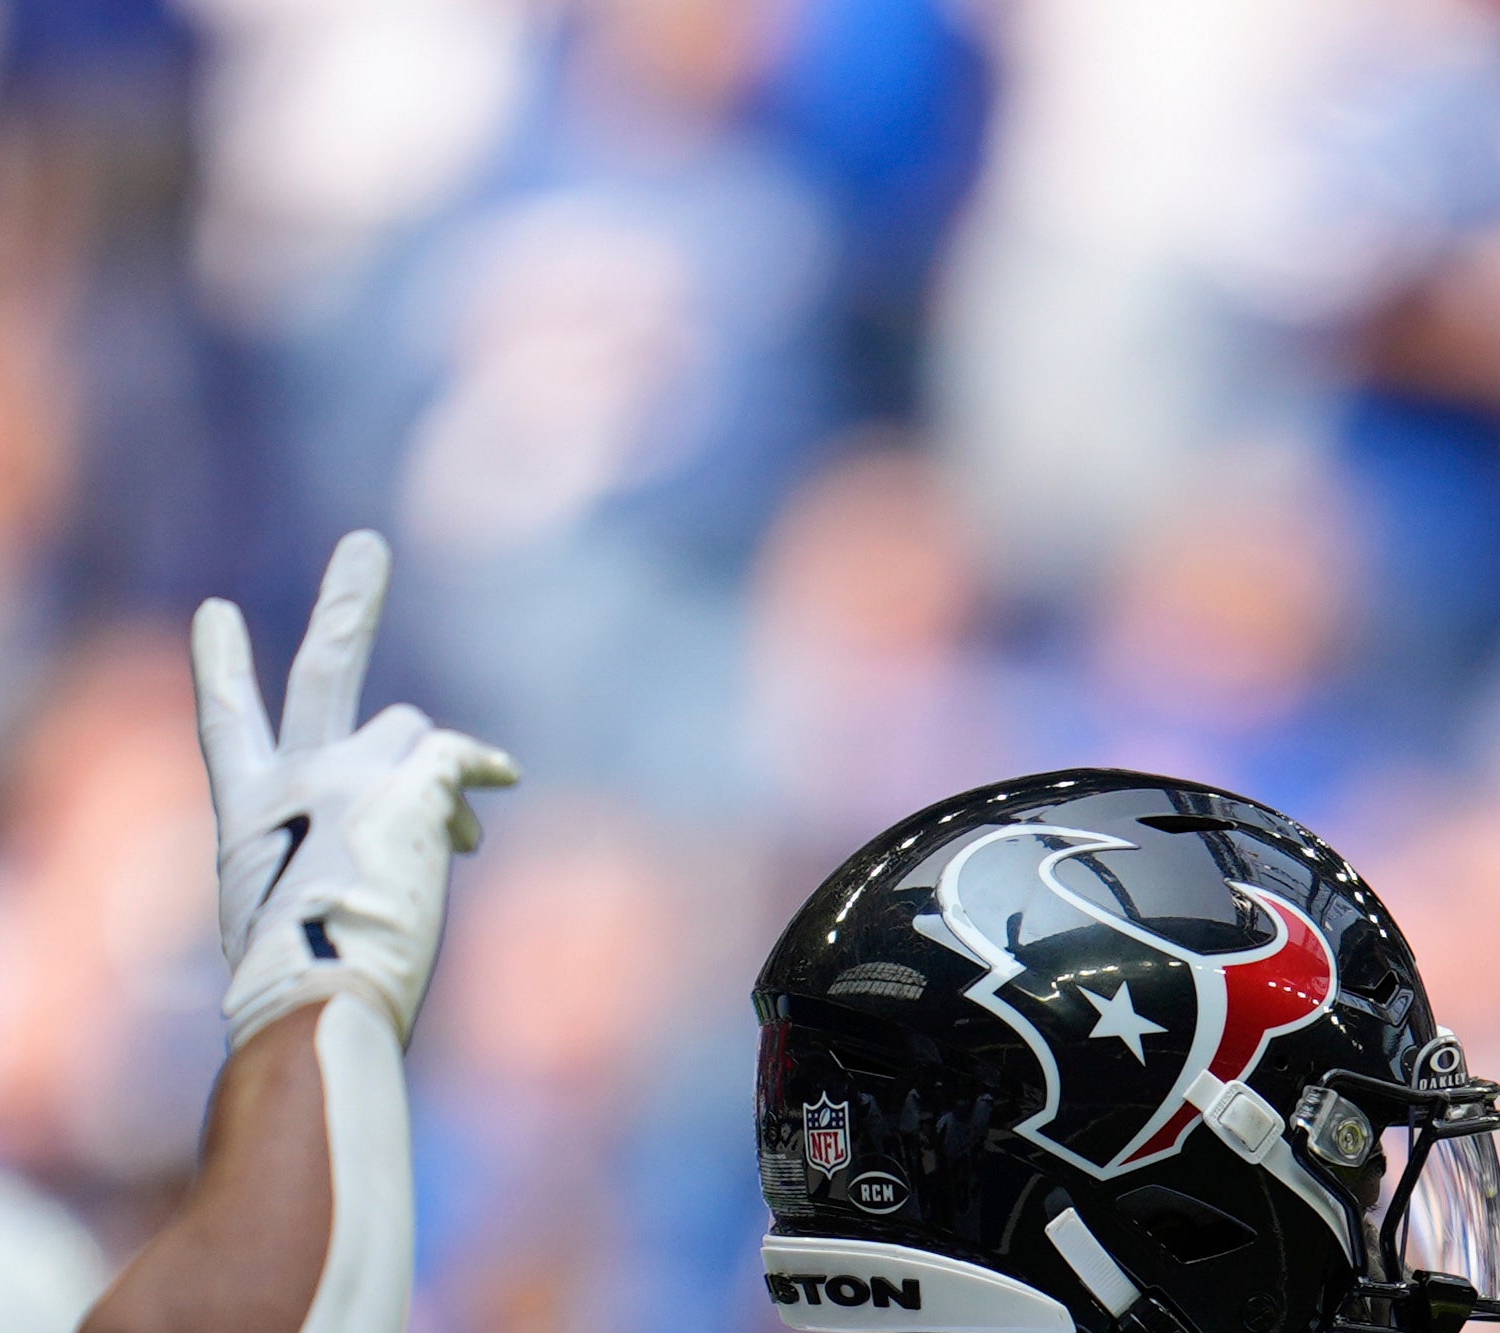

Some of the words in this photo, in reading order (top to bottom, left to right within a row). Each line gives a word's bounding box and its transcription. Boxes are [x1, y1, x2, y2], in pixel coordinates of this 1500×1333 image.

[1419, 1072, 1466, 1091] OAKLEY
[810, 1131, 844, 1164] NFL
[861, 1184, 894, 1202] RCM
